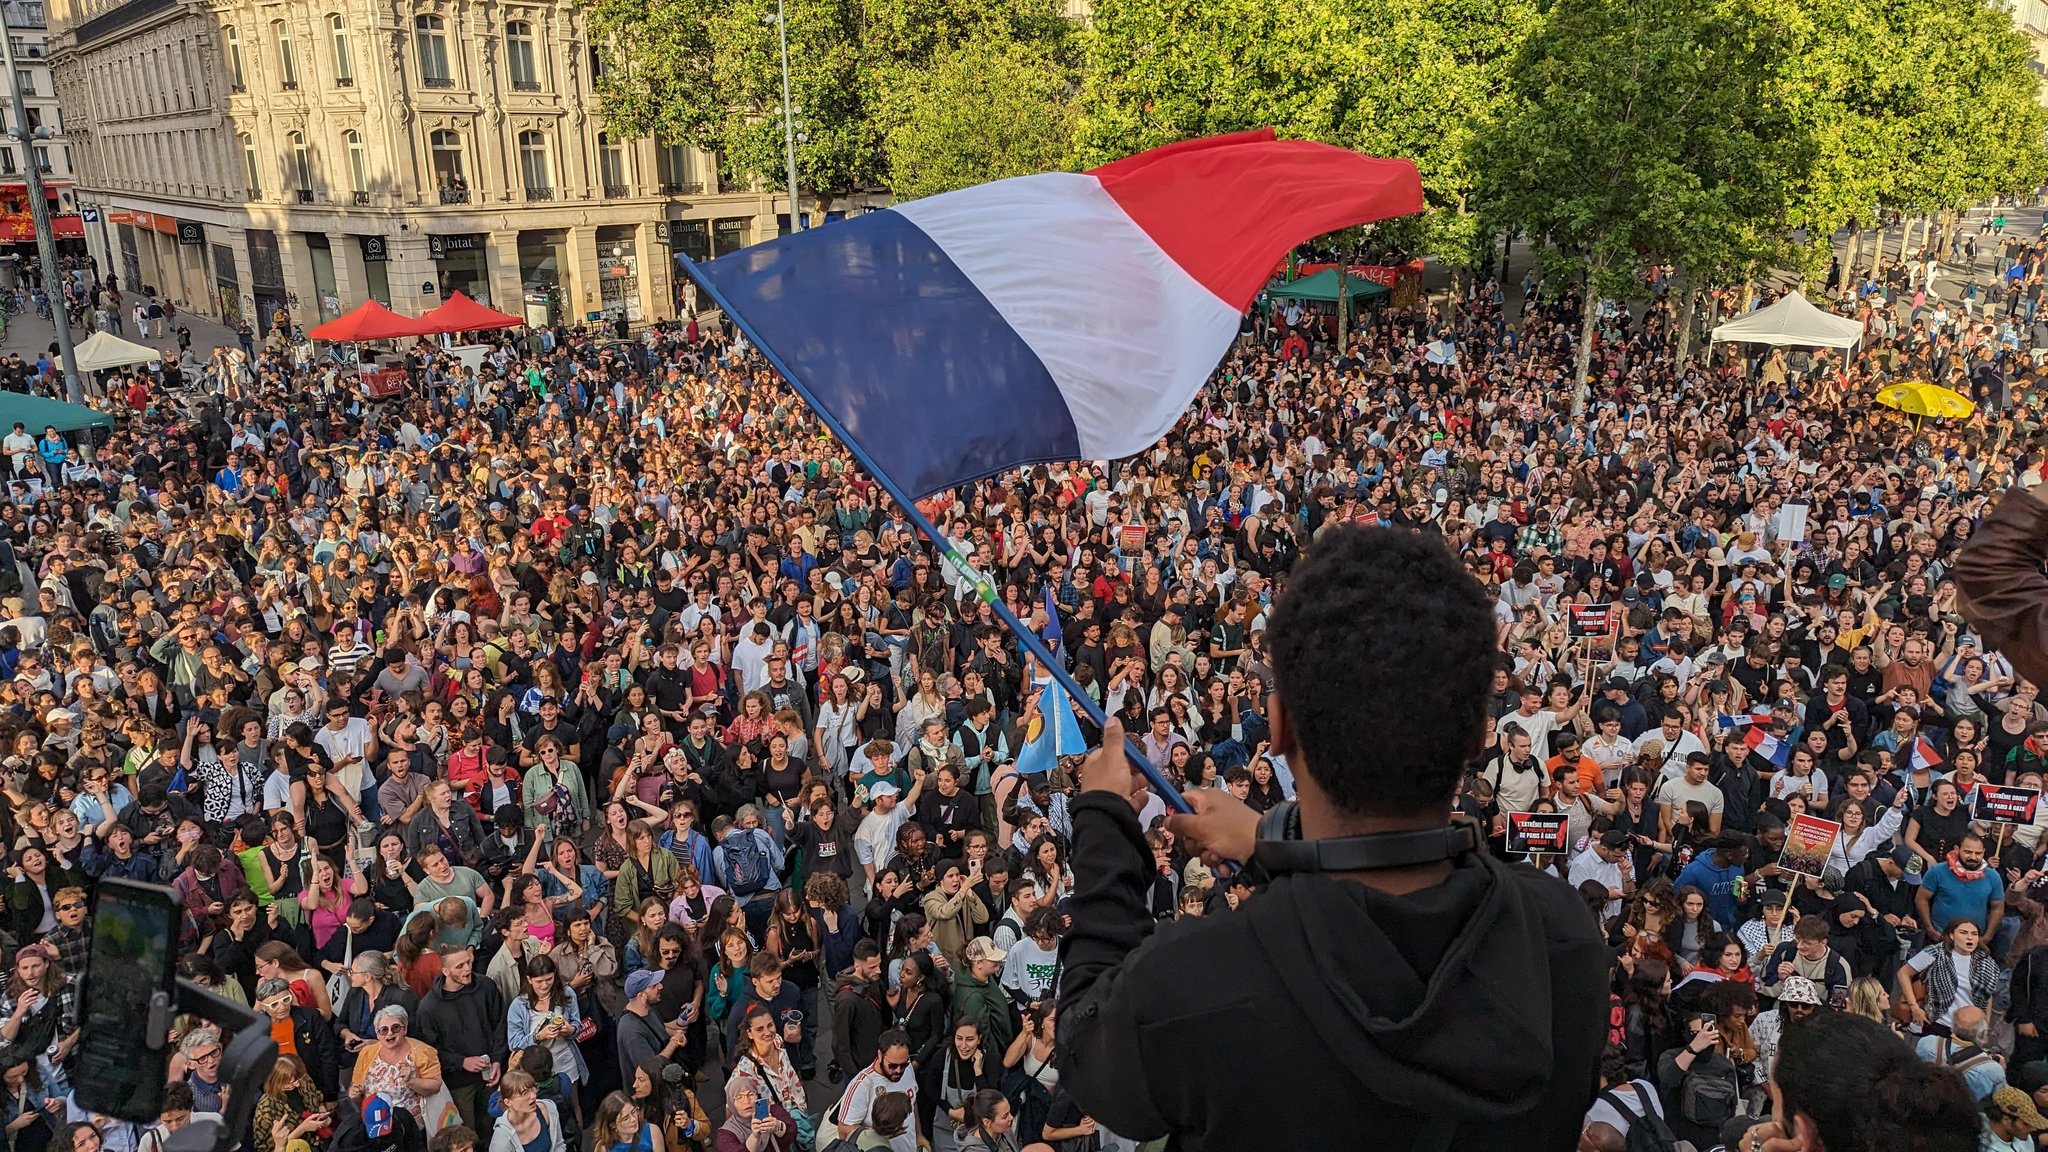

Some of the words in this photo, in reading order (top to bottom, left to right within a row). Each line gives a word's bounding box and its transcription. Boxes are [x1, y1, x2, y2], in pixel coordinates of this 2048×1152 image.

[445, 237, 472, 249] bitat
[1517, 820, 1542, 828] L'EXTRÊME
[819, 842, 836, 851] FREE
[1026, 963, 1057, 971] NORT
